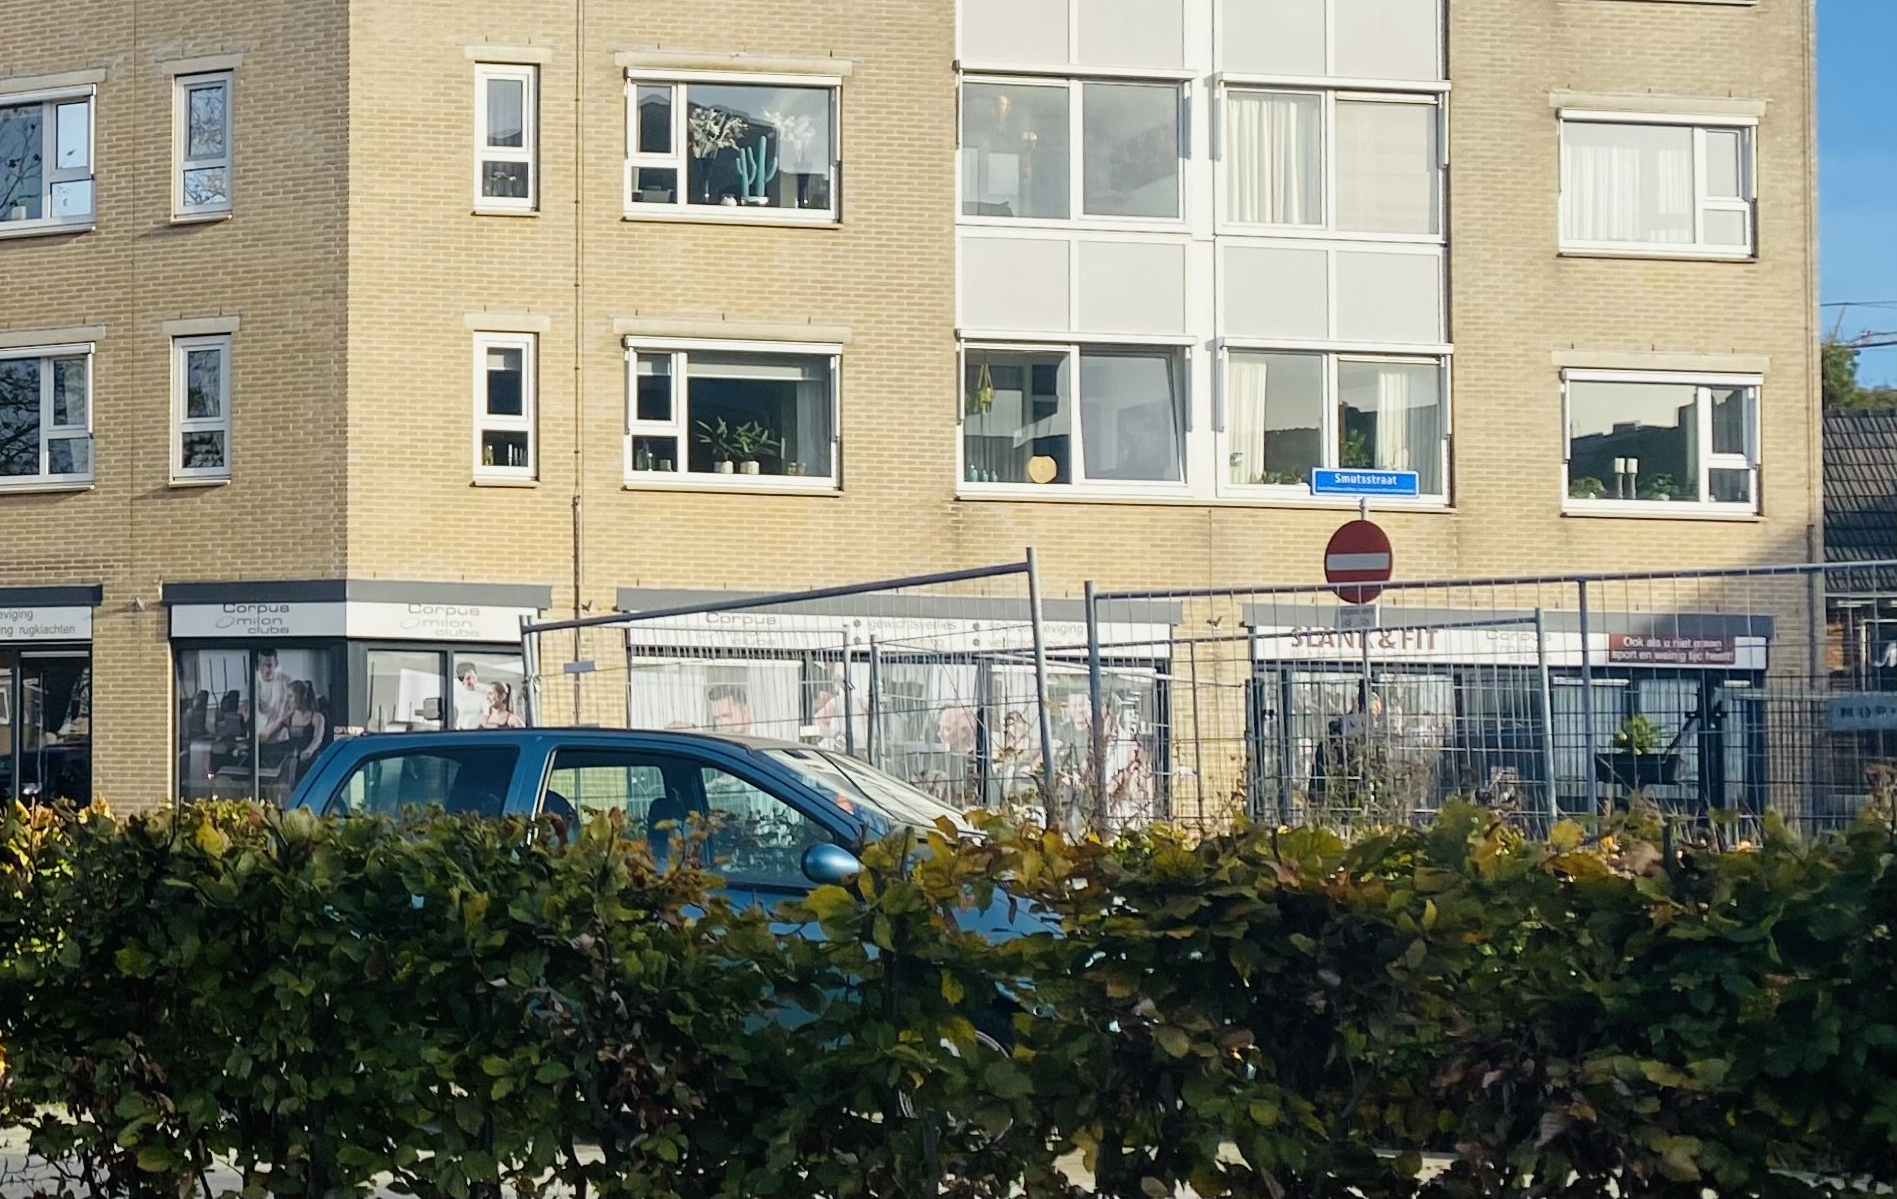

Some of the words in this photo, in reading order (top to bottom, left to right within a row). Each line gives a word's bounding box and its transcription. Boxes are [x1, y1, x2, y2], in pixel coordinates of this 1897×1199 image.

[1335, 473, 1398, 485] Smutsstraat
[223, 603, 290, 614] Corpus
[408, 603, 480, 617] Corpus
[236, 614, 283, 625] milon
[422, 615, 473, 628] milon
[19, 624, 75, 637] rugklachten
[247, 625, 290, 634] clubs
[1623, 636, 1643, 647] Ook
[1611, 650, 1637, 660] sport
[1639, 650, 1652, 660] en
